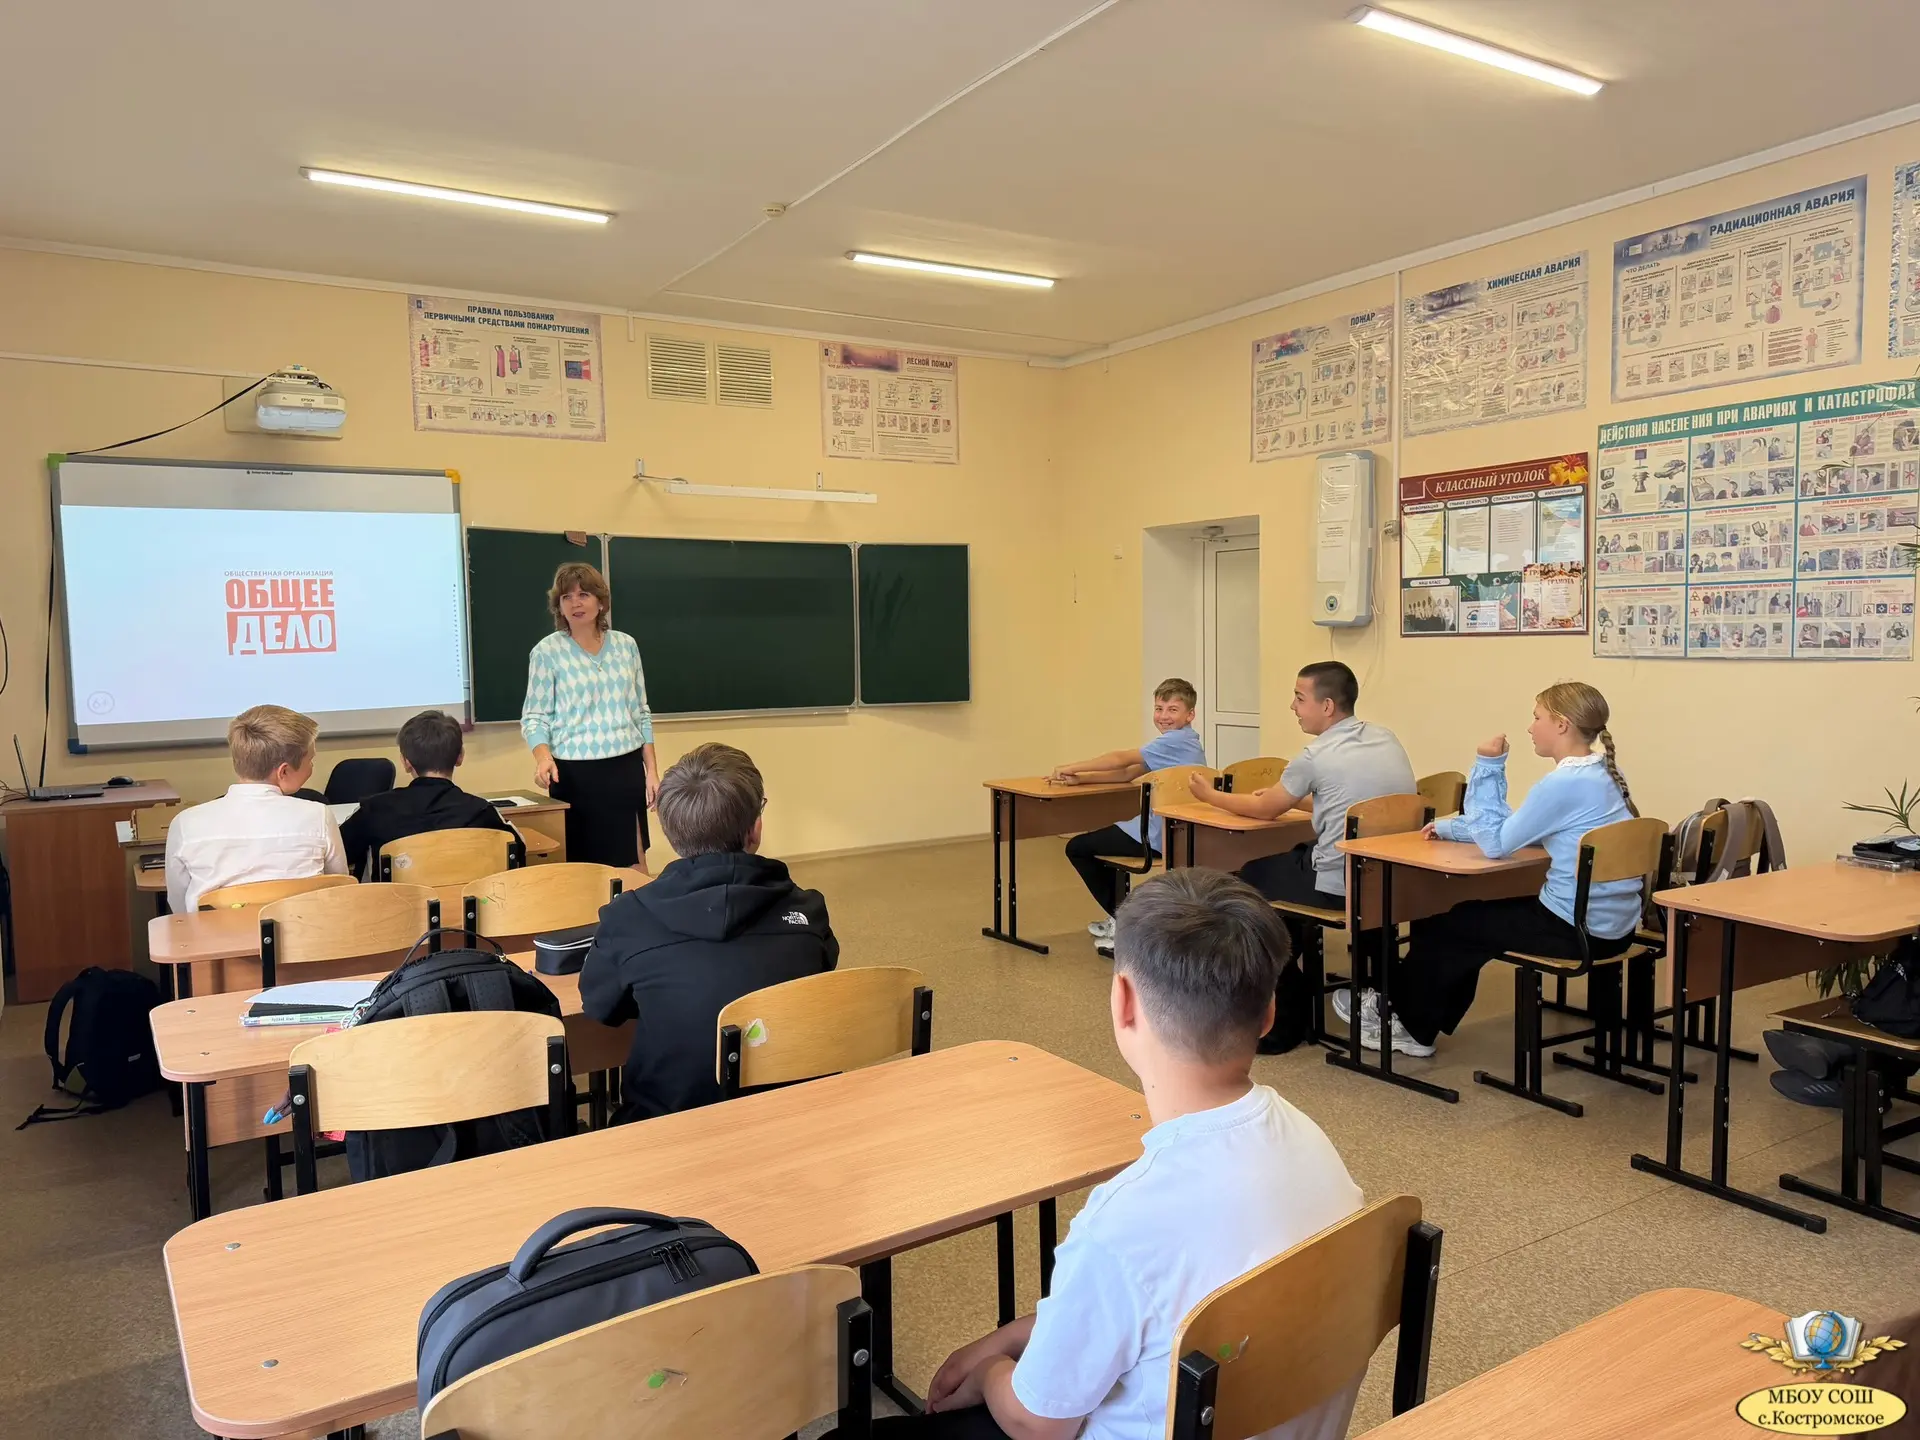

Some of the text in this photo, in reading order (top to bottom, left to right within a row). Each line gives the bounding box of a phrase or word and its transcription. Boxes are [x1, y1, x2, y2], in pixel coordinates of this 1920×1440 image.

[1709, 202, 1801, 236] РАДИАЦИОННАЯ
[1804, 188, 1855, 212] АВАРИЯ
[1486, 267, 1542, 291] ХИМИЧЕСКАЯ
[1544, 256, 1581, 275] АВАРИЯ
[424, 311, 590, 335] ПЕРВИЧНЫМИ СРЕДСТВАМИ ПОЖАРОТУШЕНИЯ
[467, 305, 555, 321] ПРАВИЛА ПОЛЬЗОВАНИЯ
[1350, 312, 1376, 327] ПОЖАР
[906, 357, 953, 369] ЛЕСНОЙ ПОЖАР
[1599, 422, 1648, 445] ДЕЙСТВИЯ
[1716, 408, 1739, 426] ПРИ
[1743, 400, 1797, 422] АВАРИЯХ
[1804, 397, 1813, 413] И
[1817, 383, 1916, 411] КАТАСТРОФАХ
[1435, 468, 1547, 493] КЛАССНЫЙ УГОЛОК
[225, 578, 335, 610] ОБЩЕЕ
[232, 612, 333, 655] ДЕЛО
